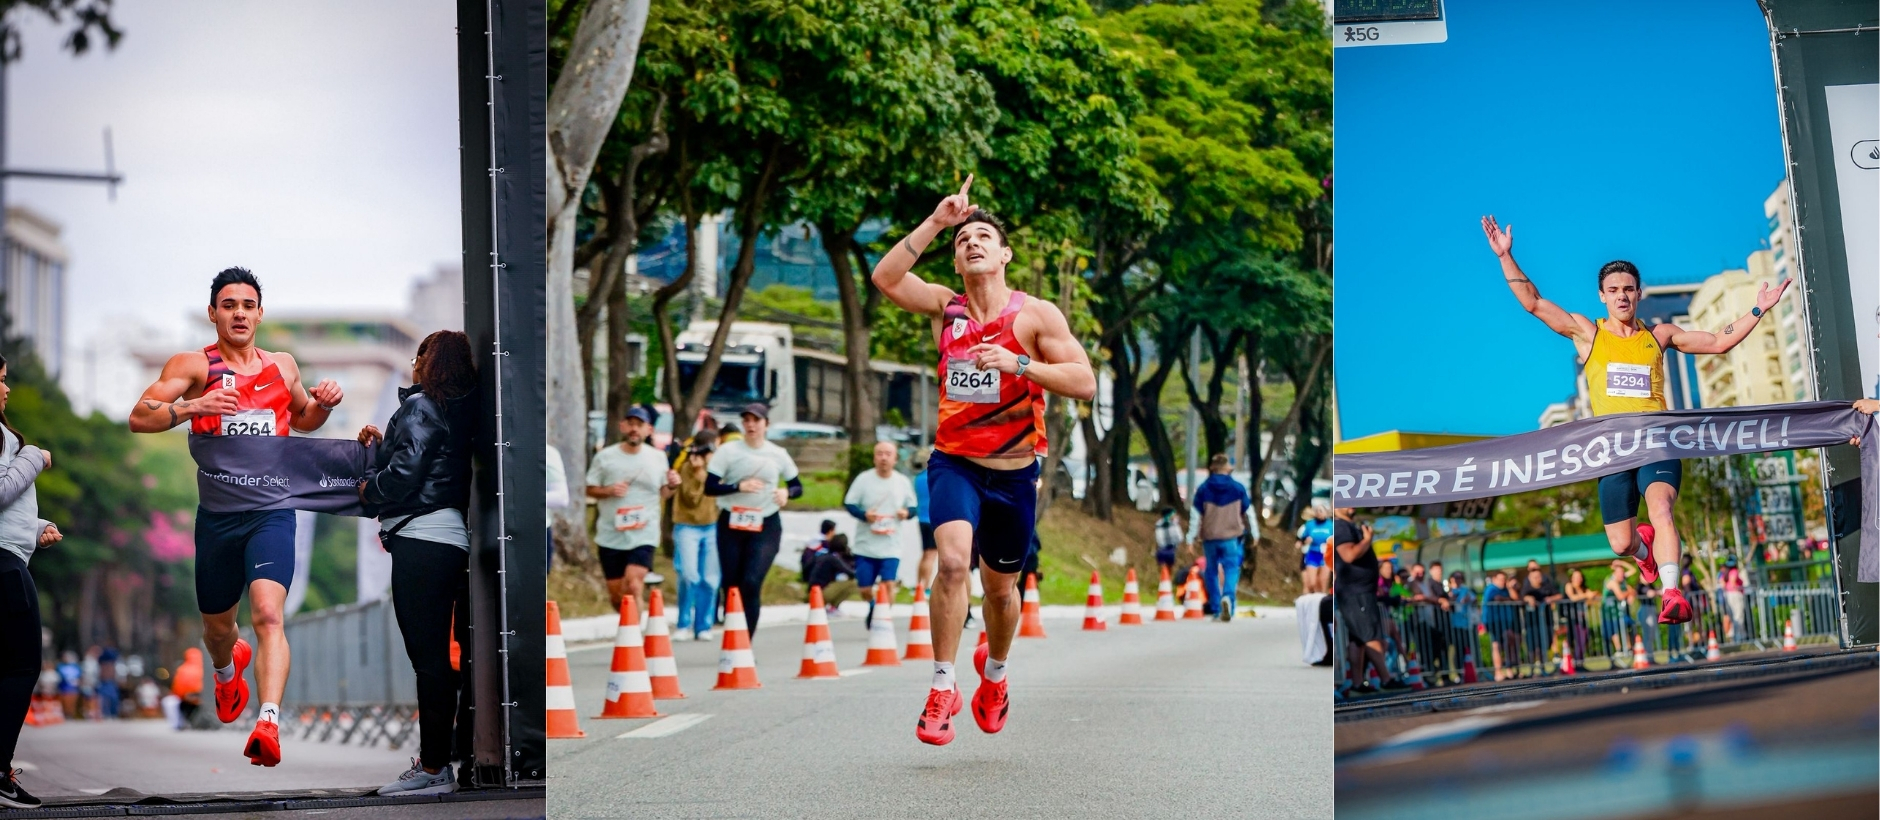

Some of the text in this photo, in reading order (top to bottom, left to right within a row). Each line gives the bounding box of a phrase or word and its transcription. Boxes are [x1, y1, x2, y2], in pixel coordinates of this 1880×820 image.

[1356, 26, 1379, 41] 5G
[950, 371, 994, 388] 6264
[1613, 375, 1645, 388] 5294
[227, 422, 271, 436] 6264
[1334, 469, 1441, 499] RRER
[1451, 456, 1477, 493] É
[1488, 415, 1791, 489] INESQUECÍVEL!
